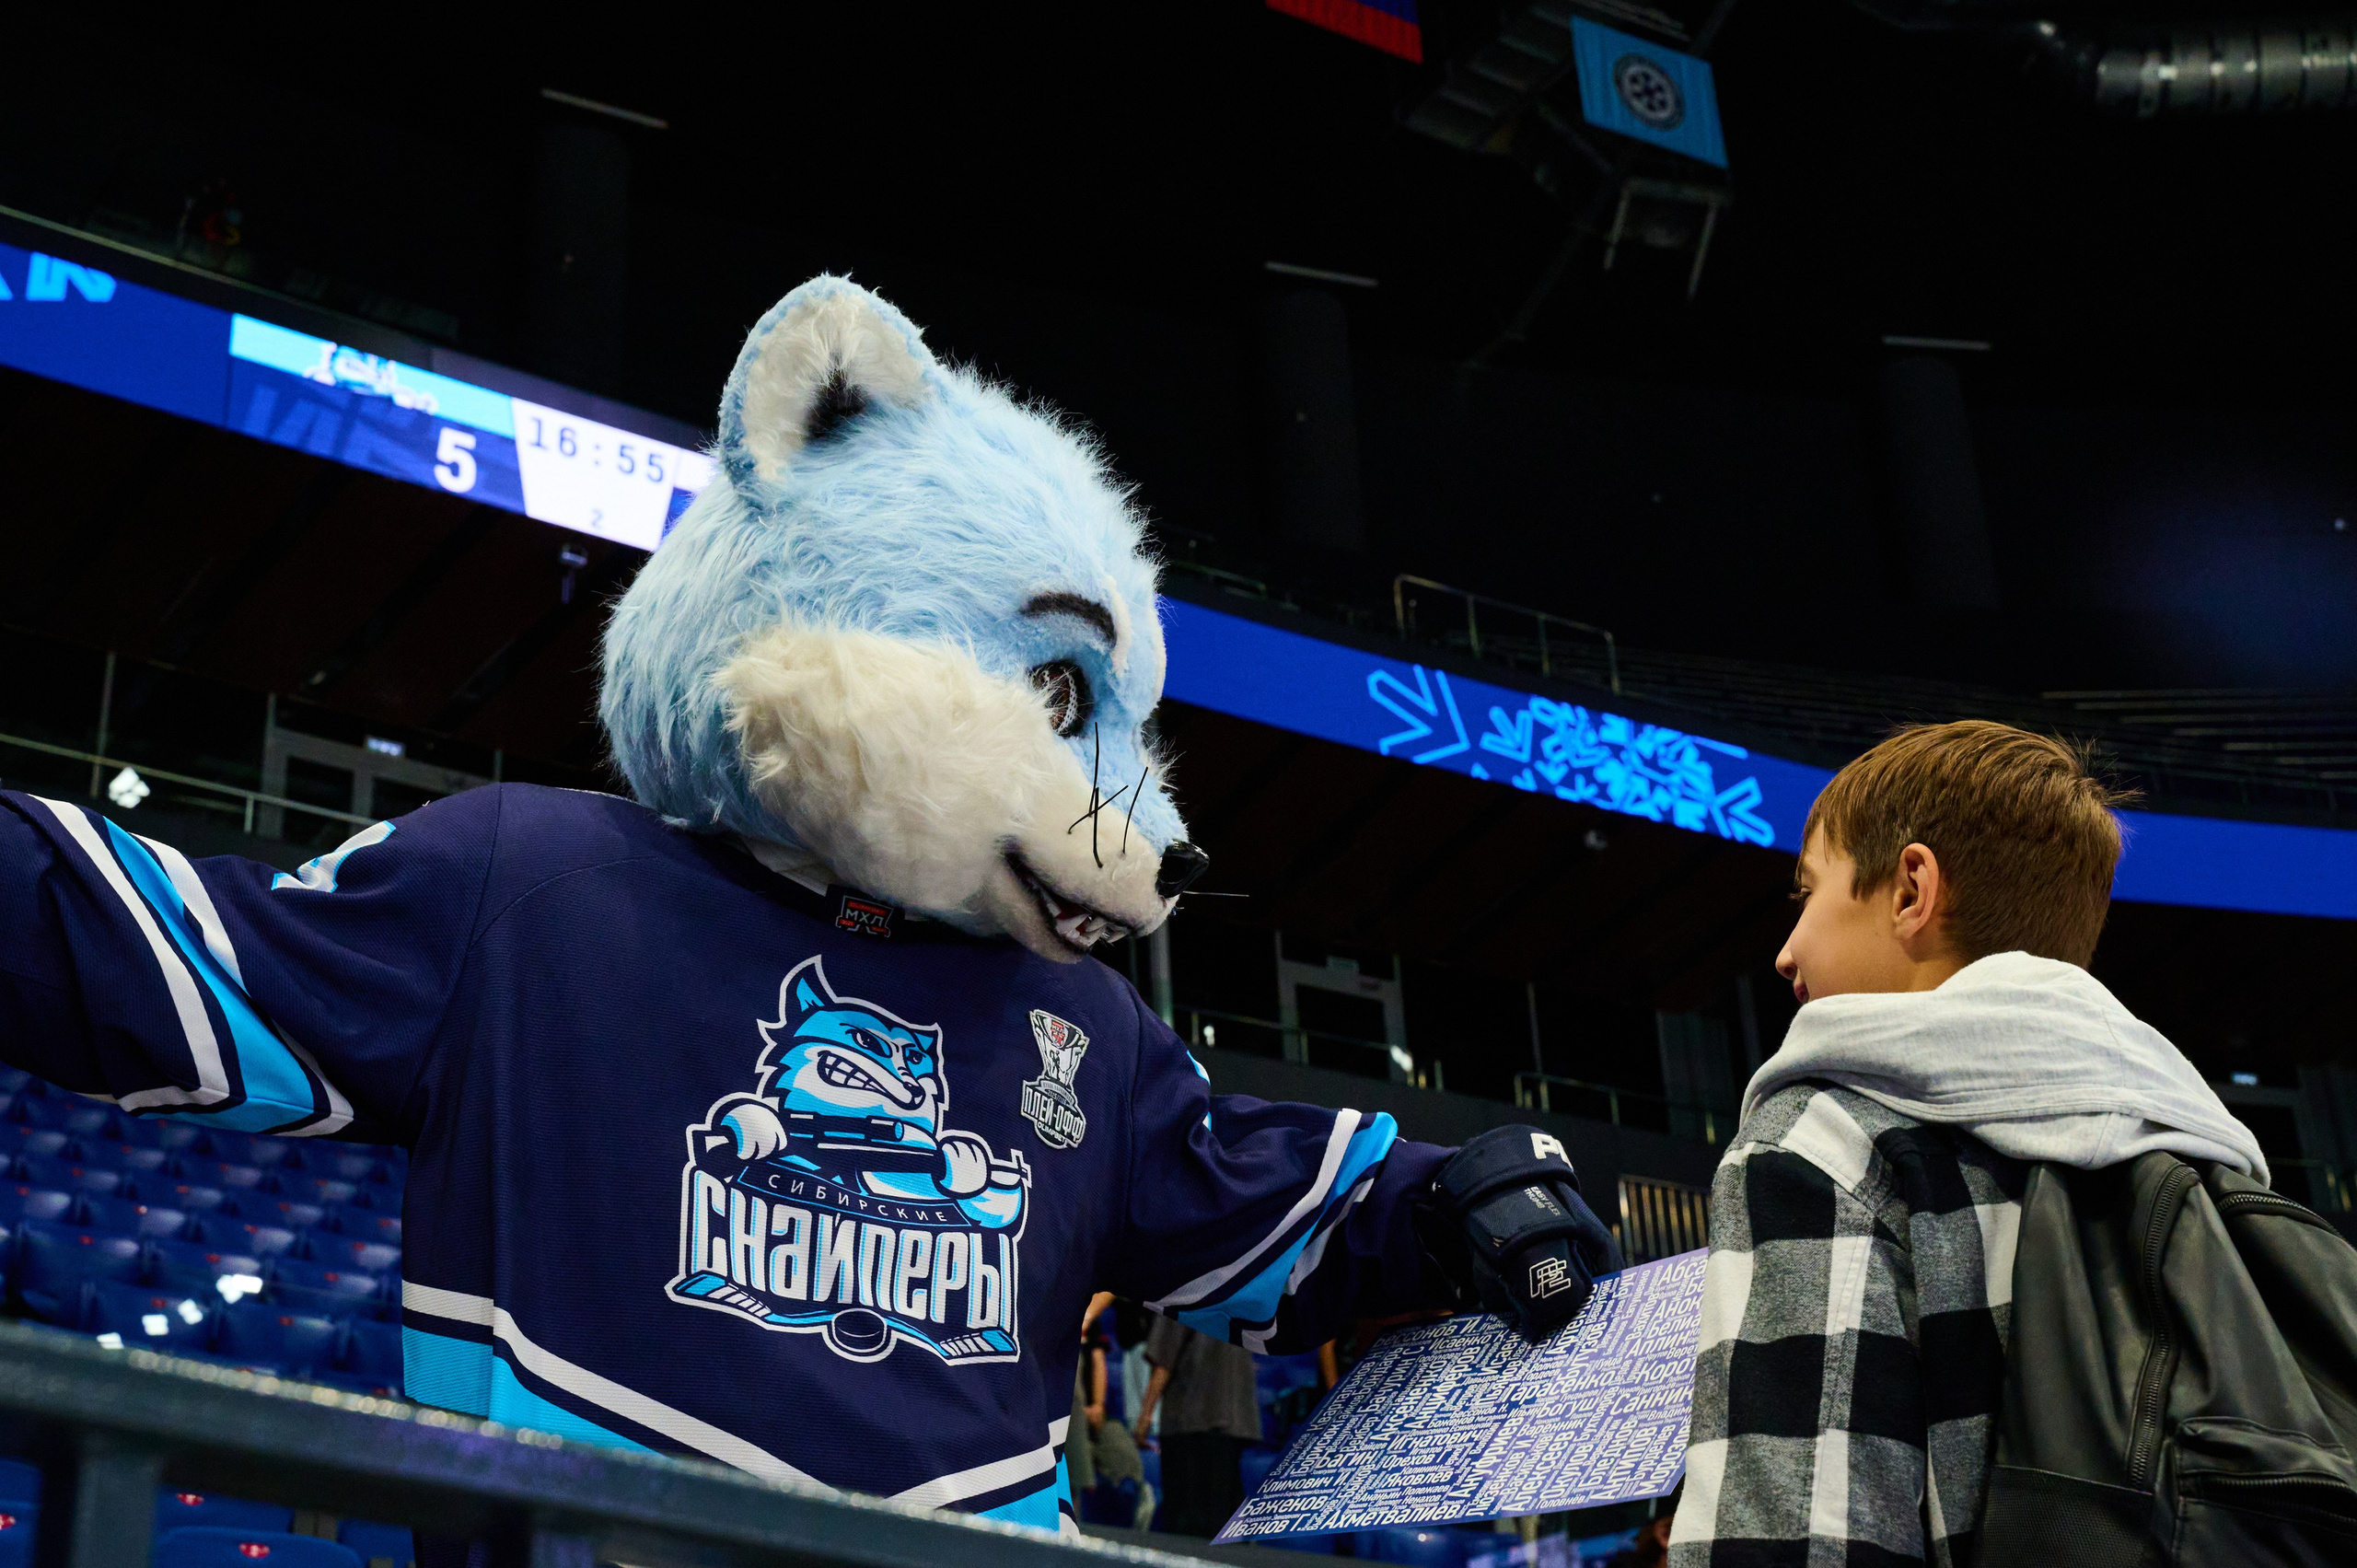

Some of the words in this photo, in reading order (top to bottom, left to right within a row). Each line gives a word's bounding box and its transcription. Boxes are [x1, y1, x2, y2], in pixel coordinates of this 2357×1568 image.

[434, 426, 477, 494] 5
[528, 416, 666, 484] 16:55
[845, 908, 884, 927] МХЛ
[1024, 1086, 1084, 1142] ПЛЕЙ-ОФФ
[767, 1174, 947, 1223] СИБИРСКИЕ
[1582, 1277, 1615, 1325] Вешуткин
[1620, 1268, 1653, 1319] Евтушенко
[1458, 1317, 1486, 1334] И.
[1623, 1291, 1661, 1341] Вахитов
[1427, 1333, 1493, 1351] Исаенко
[1492, 1328, 1514, 1342] К.
[1554, 1318, 1612, 1381] Бутузов
[1623, 1329, 1692, 1359] Аплин
[1349, 1345, 1407, 1397] Бондарь
[1460, 1373, 1502, 1385] Давыдов
[1474, 1358, 1525, 1406] Пьянов
[1527, 1358, 1565, 1372] Волков
[1305, 1359, 1377, 1432] Квартальнов
[1354, 1354, 1420, 1414] Бачурин
[1399, 1343, 1485, 1432] Анциферов
[1448, 1383, 1480, 1411] Ветров
[1496, 1369, 1618, 1404] Тарасенко
[1448, 1404, 1499, 1419] Бессонов
[1535, 1396, 1600, 1419] Богуш
[1572, 1384, 1622, 1442] Бухтояров
[1337, 1414, 1383, 1453] Вейбер
[1386, 1427, 1487, 1450] Игнатович
[1467, 1421, 1502, 1455] Волохин
[1515, 1417, 1587, 1437] Варенник
[1288, 1420, 1347, 1475] Борисюк
[1313, 1449, 1379, 1469] Багин
[1377, 1452, 1437, 1471] Орехов
[1408, 1445, 1445, 1456] Игнатов
[1444, 1415, 1527, 1500] Ануфриев
[1498, 1434, 1554, 1495] Васильков
[1576, 1418, 1642, 1487] Бледнов
[1587, 1424, 1660, 1502] Антипов
[1624, 1423, 1678, 1481] Бурделёв
[1255, 1475, 1335, 1493] Климович
[1330, 1470, 1354, 1486] И.
[1335, 1462, 1377, 1498] Быков
[1380, 1469, 1456, 1488] Яковлев
[1398, 1464, 1441, 1475] Калинин
[1463, 1450, 1527, 1517] Люзенков
[1498, 1429, 1577, 1513] Алексеев
[1537, 1443, 1596, 1500] Окулов
[1236, 1494, 1330, 1517] Баженов
[1356, 1490, 1403, 1503] Ананьин
[1399, 1493, 1444, 1504] Ненахов
[1400, 1483, 1451, 1495] Полежаев
[1534, 1493, 1587, 1509] Головнёв
[1220, 1519, 1292, 1539] Иванов
[1288, 1513, 1312, 1532] Г.
[1318, 1504, 1462, 1529] Ахметвалиев
